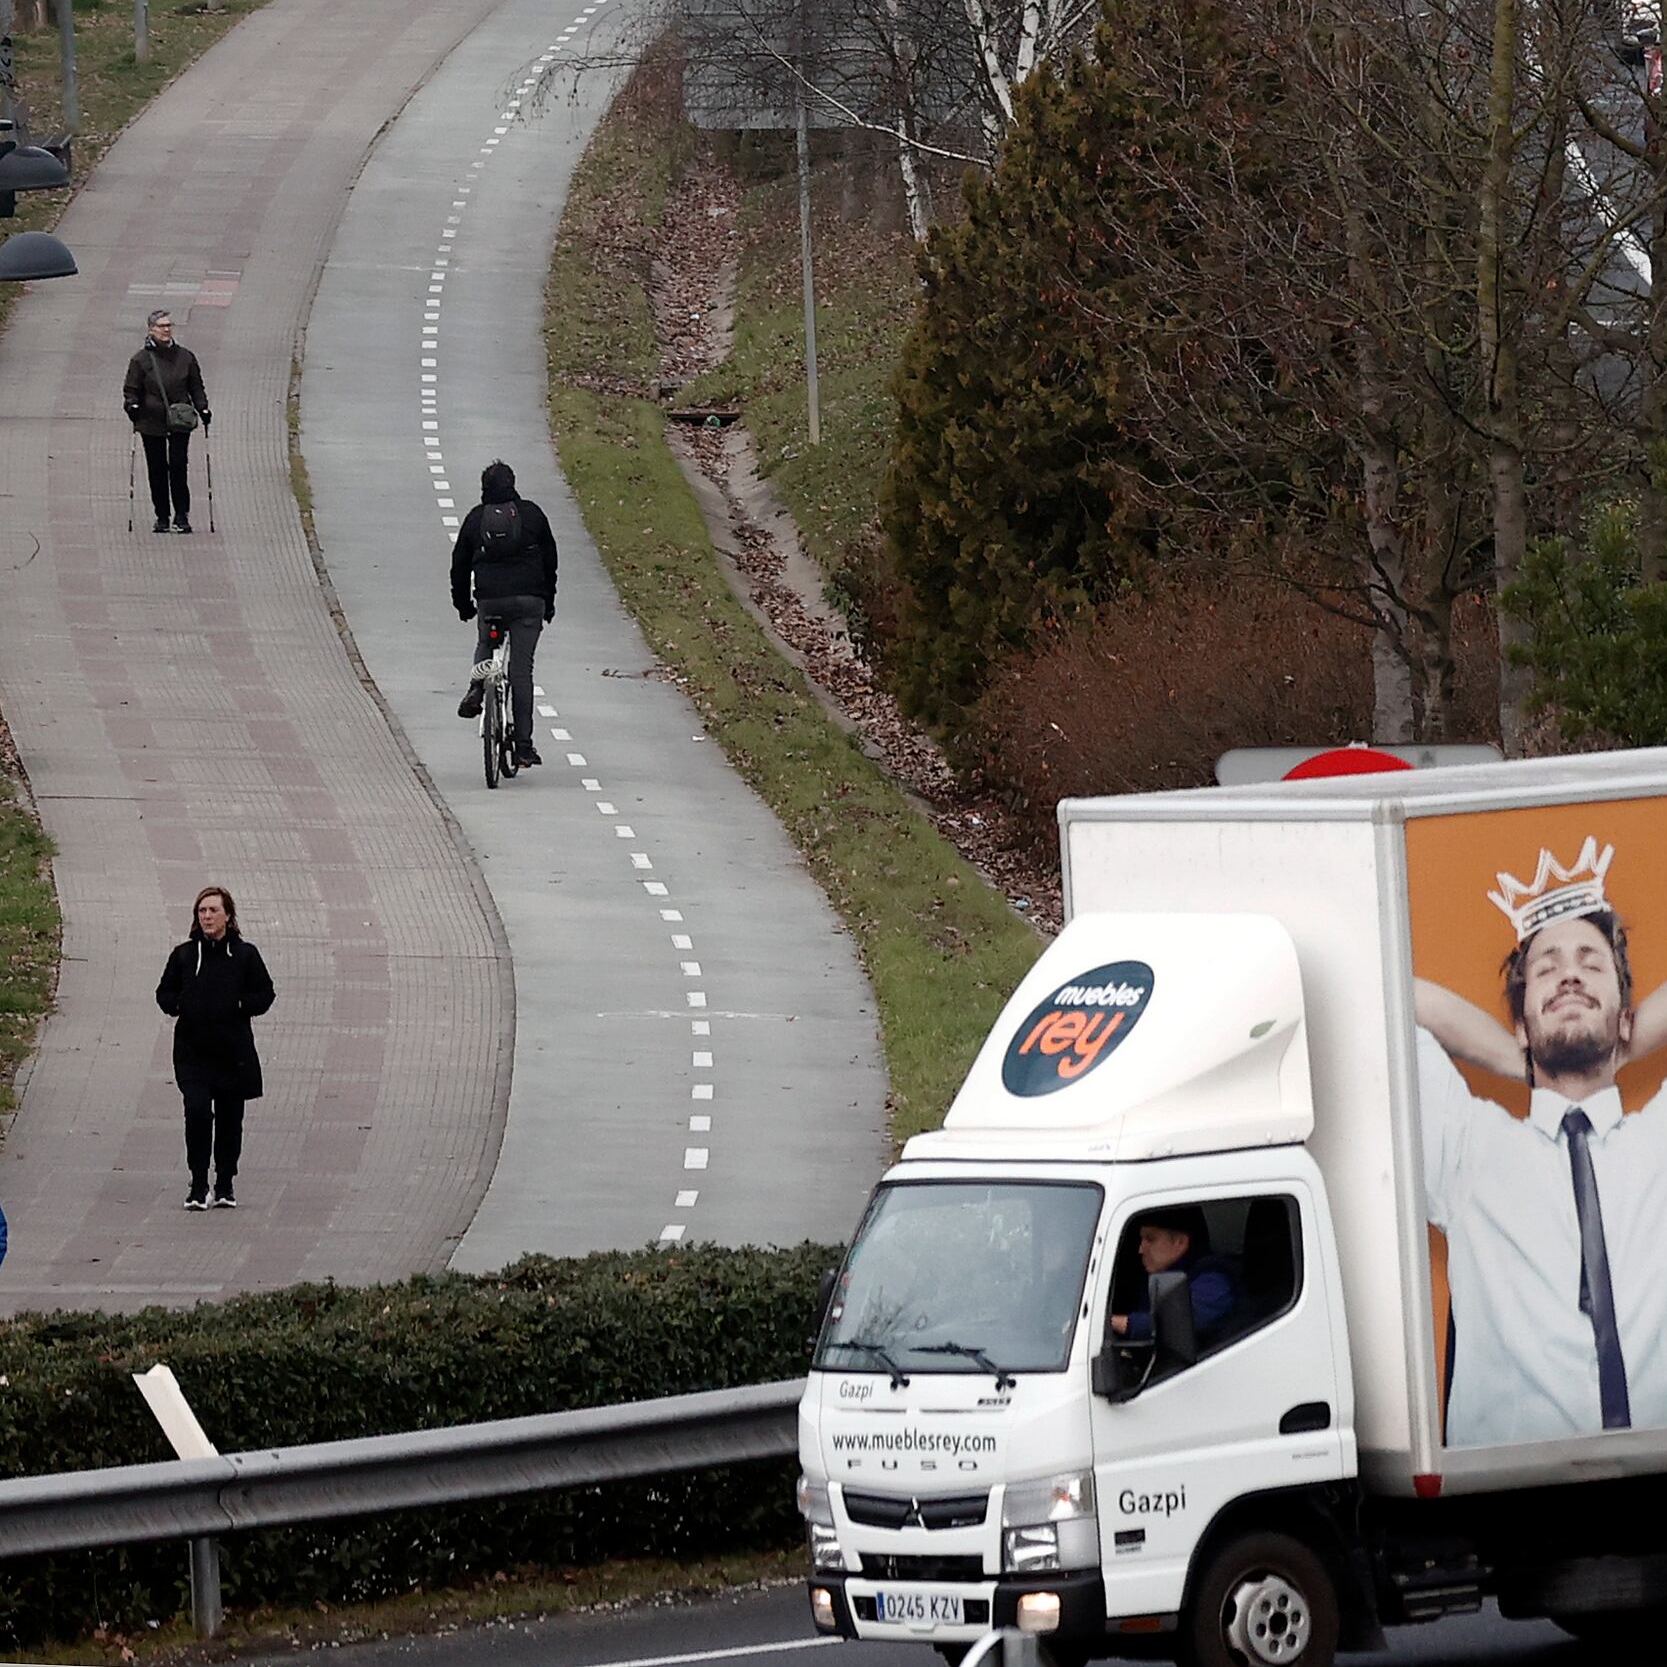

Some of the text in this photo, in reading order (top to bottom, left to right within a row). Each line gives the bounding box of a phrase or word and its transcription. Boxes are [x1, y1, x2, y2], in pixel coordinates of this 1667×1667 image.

[1054, 981, 1146, 1007] muebles
[1018, 1010, 1126, 1079] rey
[839, 1380, 874, 1403] Gazpi
[832, 1428, 997, 1457] www.mueblesrey.com
[847, 1458, 978, 1472] FUSO
[1119, 1484, 1187, 1518] Gazpi
[886, 1593, 960, 1622] 0245 KZV
